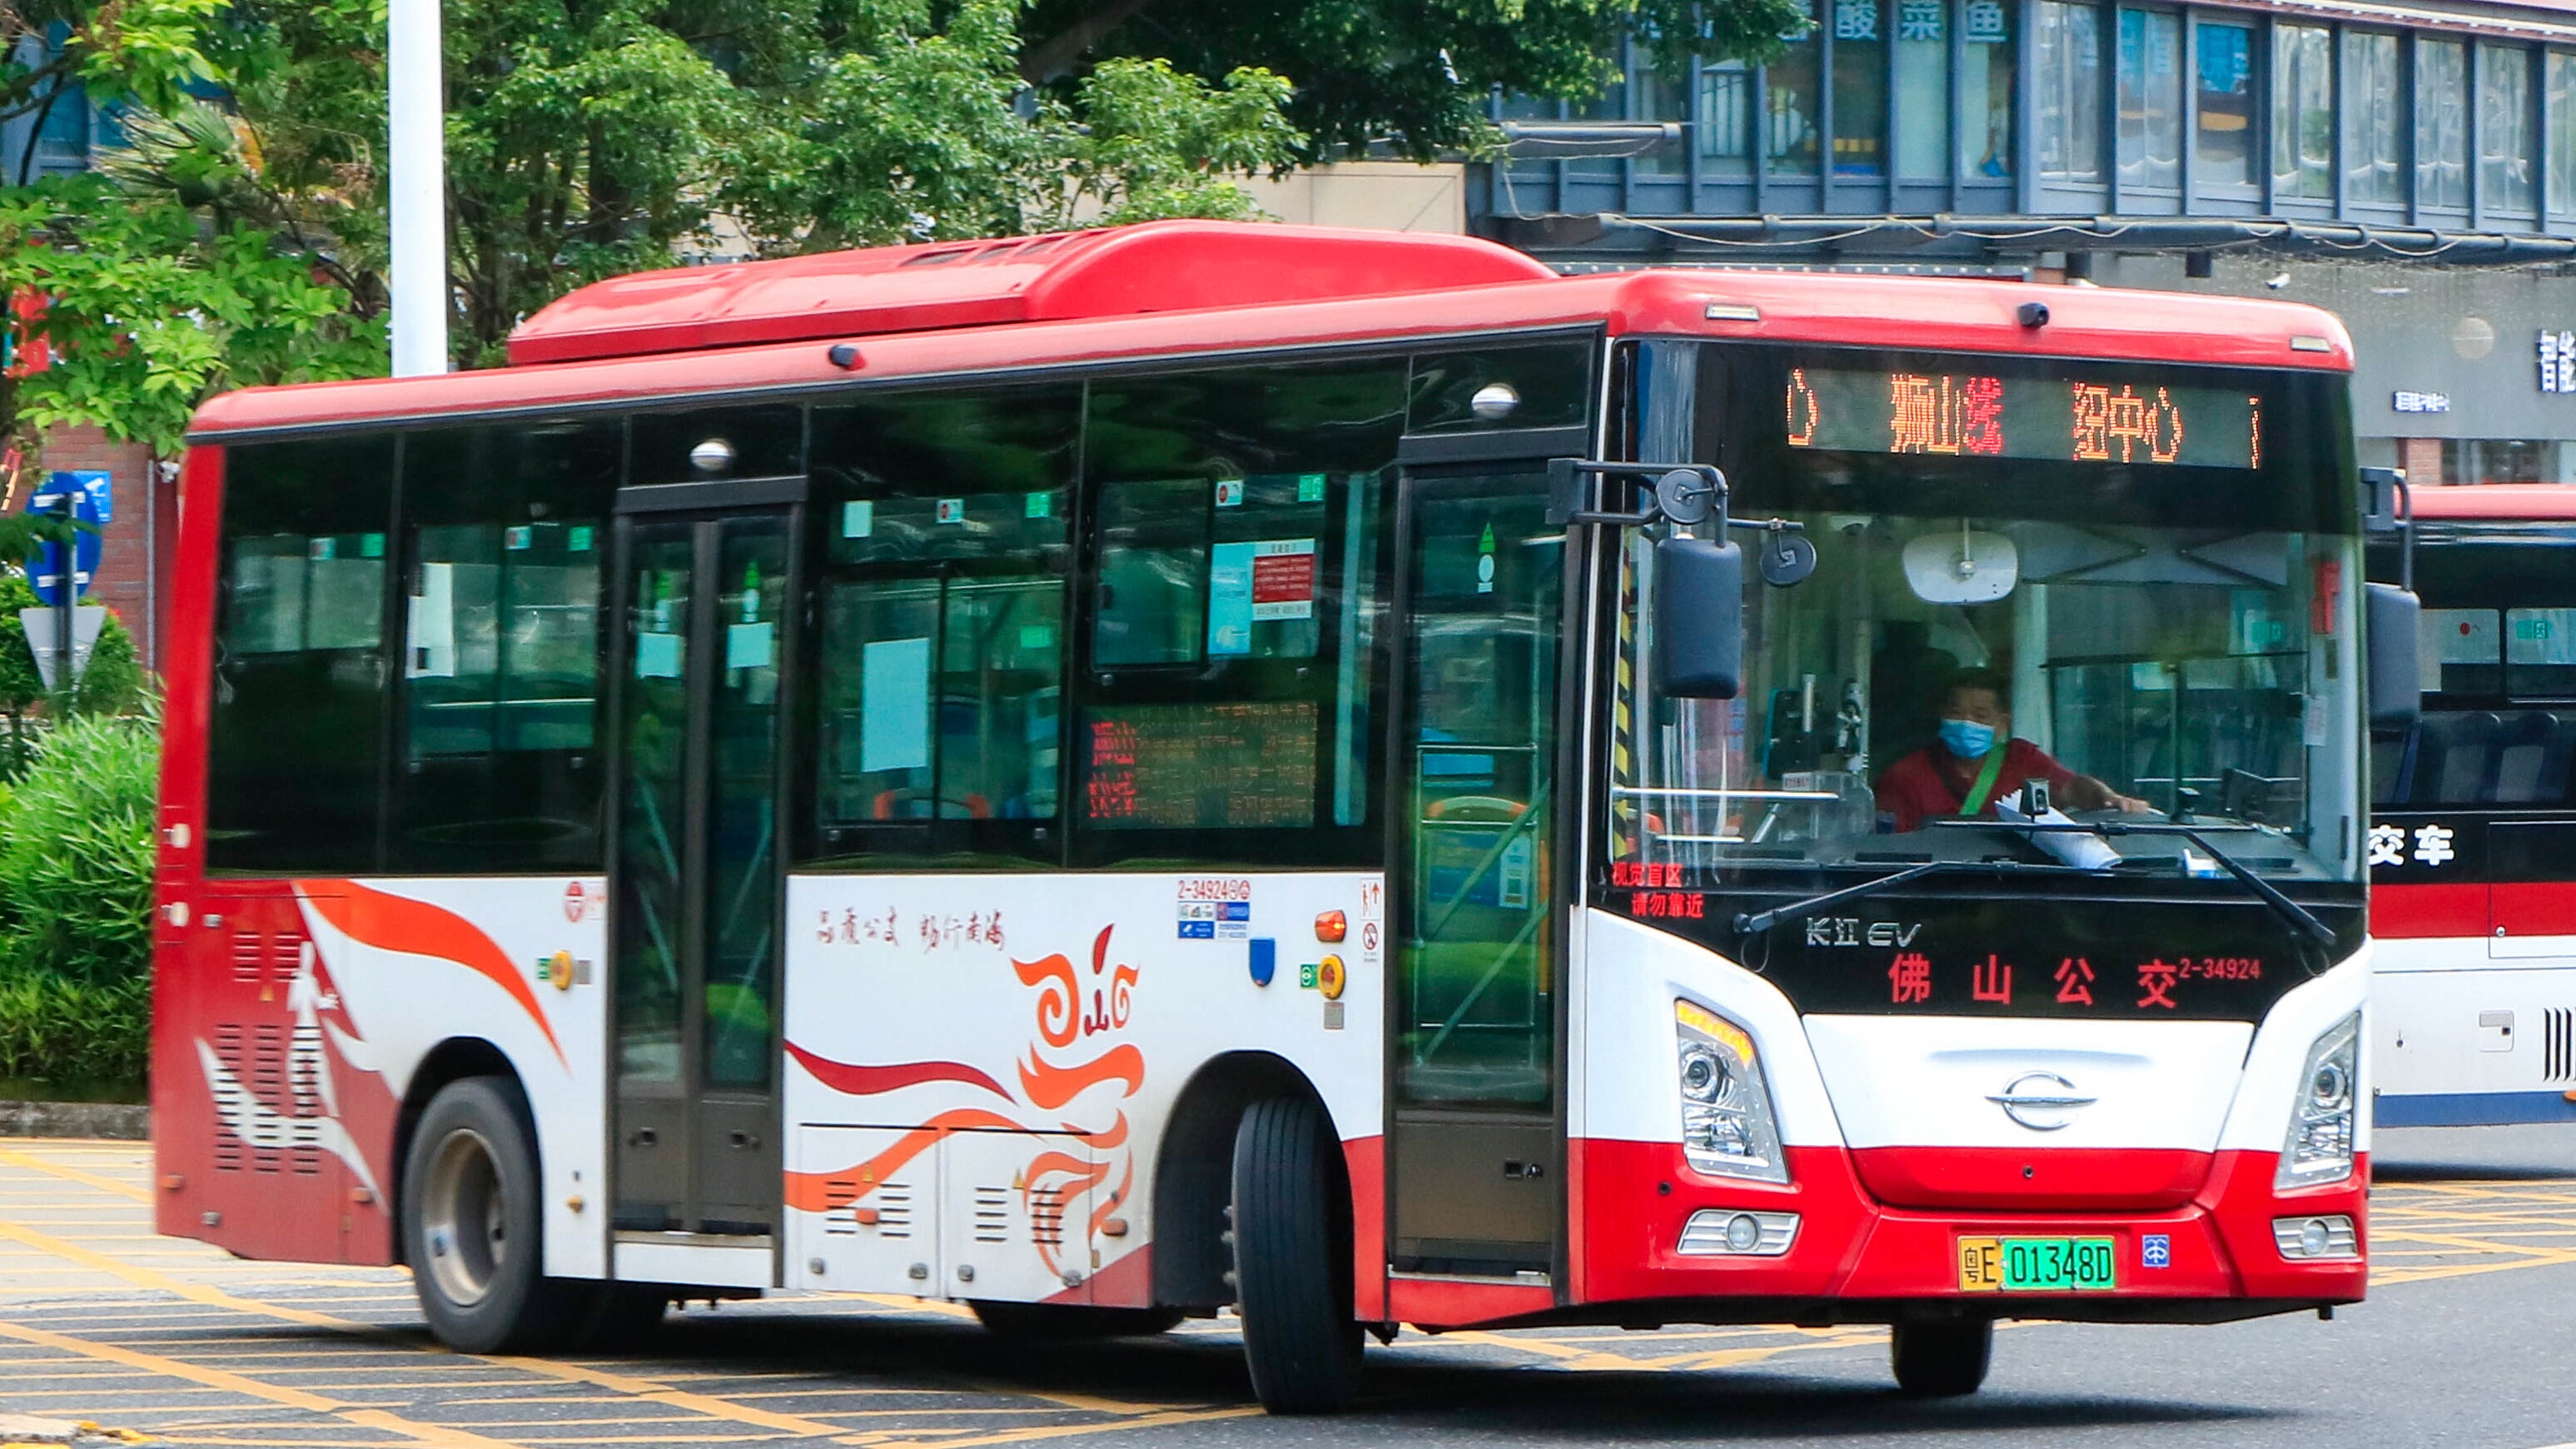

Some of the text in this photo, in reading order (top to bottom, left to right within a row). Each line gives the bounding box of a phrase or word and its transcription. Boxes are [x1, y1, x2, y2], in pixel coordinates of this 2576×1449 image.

[1612, 861, 1683, 888] 视觉盲区
[1177, 879, 1229, 899] 2-34924
[1632, 891, 1704, 919] 请勿靠近
[1887, 953, 2177, 1009] 佛山公交
[2179, 958, 2262, 979] 2-34924
[2011, 1245, 2111, 1283] 01348D
